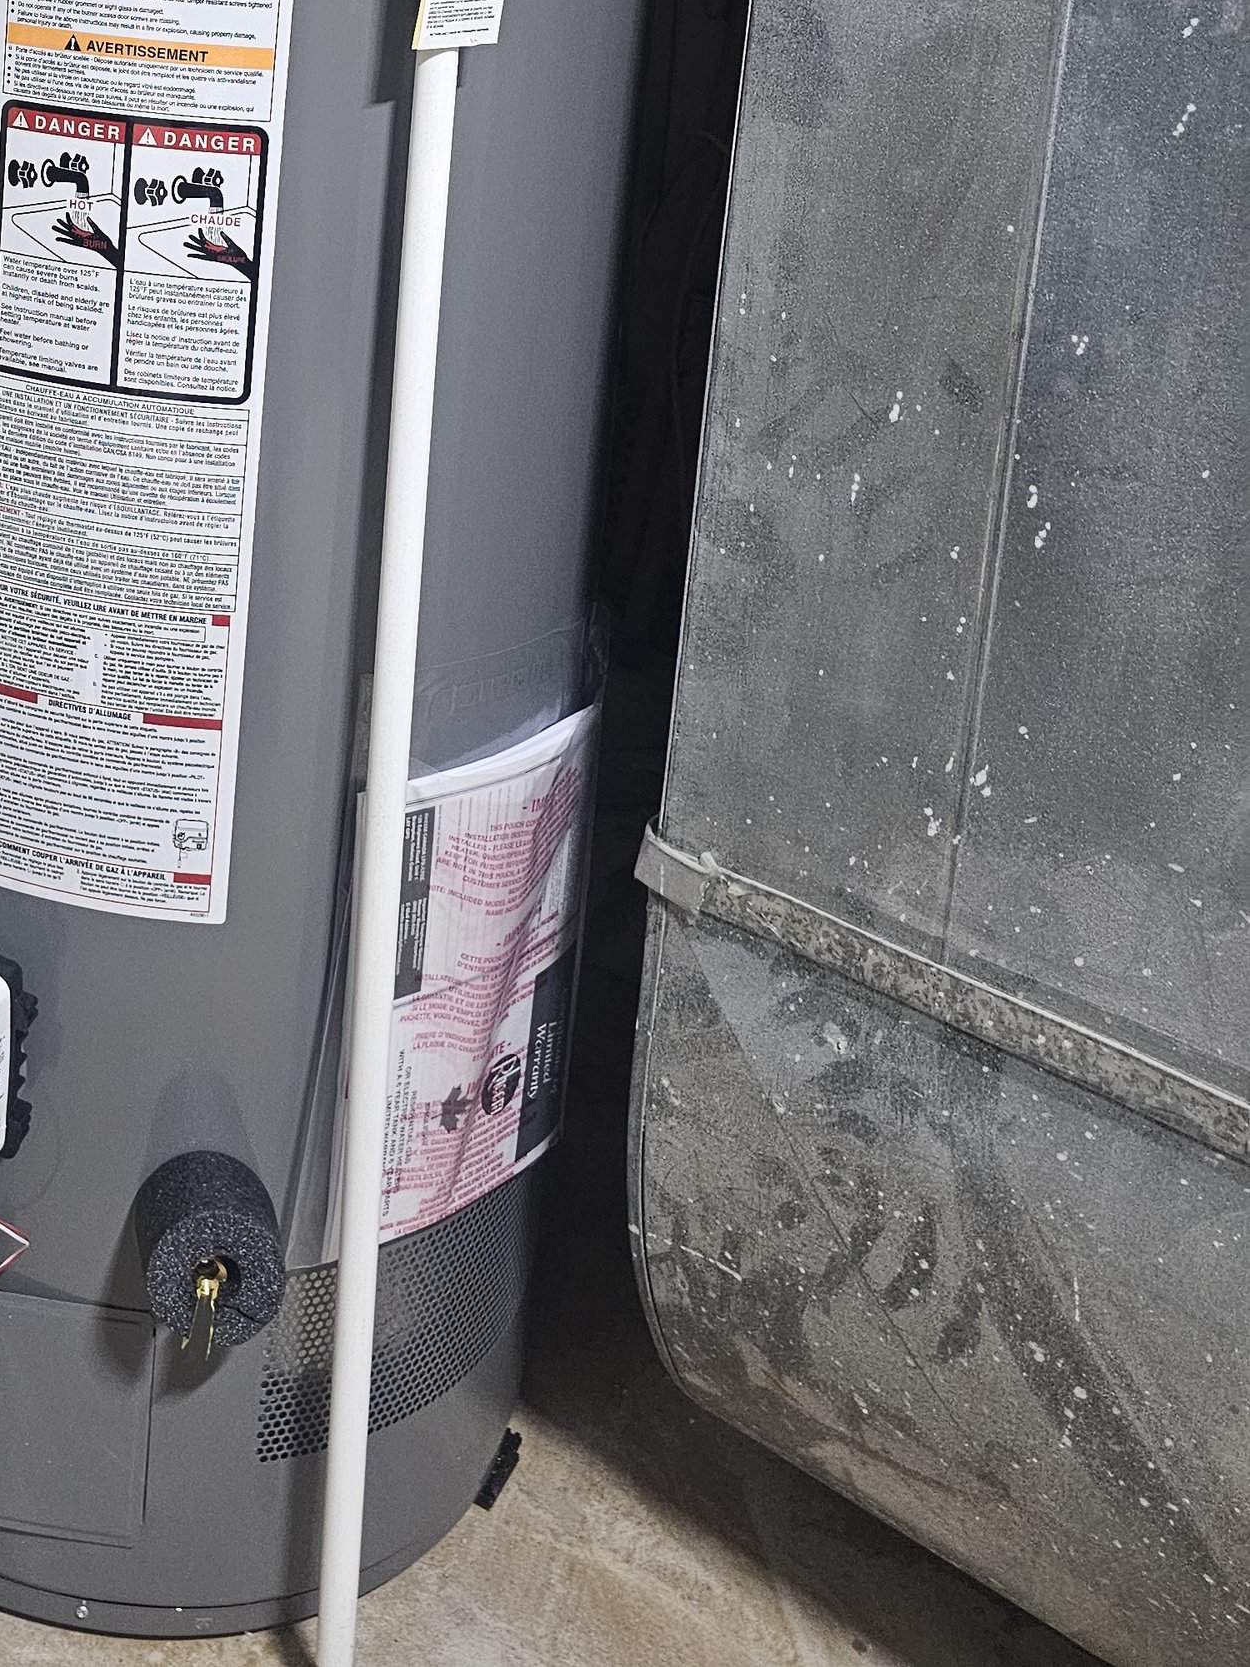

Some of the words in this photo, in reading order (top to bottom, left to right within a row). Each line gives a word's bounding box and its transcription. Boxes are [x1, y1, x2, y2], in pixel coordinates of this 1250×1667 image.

[86, 39, 208, 62] AVERTISSEMENT
[35, 115, 120, 140] DANGER
[164, 132, 255, 152] DANGER
[70, 199, 94, 211] HOT
[190, 215, 241, 227] CHAUDE
[83, 239, 107, 250] BURN
[4, 256, 22, 265] Water
[23, 258, 61, 274] temperature
[16, 266, 34, 274] cause
[36, 270, 58, 278] severe
[60, 273, 78, 282] burns
[40, 276, 57, 285] death
[59, 280, 74, 288] from
[130, 278, 146, 286] L'eau
[166, 283, 204, 293] température
[205, 286, 238, 295] supérieure
[2, 283, 30, 294] Children,
[32, 289, 59, 299] disabled
[61, 294, 73, 302] and
[75, 296, 97, 307] elderly
[9, 291, 32, 302] highest
[56, 301, 74, 310] being
[23, 313, 61, 327] temperature
[72, 323, 90, 332] water
[50, 312, 74, 322] manual
[76, 316, 96, 326] before
[0, 328, 12, 336] Feel
[14, 332, 31, 340] water
[33, 334, 53, 345] before
[55, 339, 79, 350] bathing
[0, 336, 33, 348] showering.
[39, 355, 63, 366] limiting
[65, 360, 85, 369] valves
[42, 363, 67, 373] manual.
[25, 384, 74, 400] CHAUFFE-EAU
[82, 395, 140, 409] ACCUMULATION
[141, 405, 195, 415] AUTOMATIQUE
[10, 586, 29, 597] VOTRE
[63, 599, 92, 610] VEUILLEZ
[93, 604, 105, 613] LIRE
[108, 606, 129, 616] AVANT
[131, 609, 139, 618] DE
[141, 611, 167, 621] METTRE
[169, 614, 178, 622] EN
[179, 615, 207, 624] MARCHE
[48, 699, 86, 713] DIRECTIVES
[89, 708, 131, 721] D'ALLUMAGE
[32, 850, 58, 862] COUPER
[59, 856, 93, 870] L'ARRIVÉE
[95, 863, 103, 871] DE
[105, 865, 119, 874] GAZ
[127, 869, 166, 881] L'APPAREIL
[527, 1023, 547, 1099] Warranty
[543, 1021, 557, 1083] Limited
